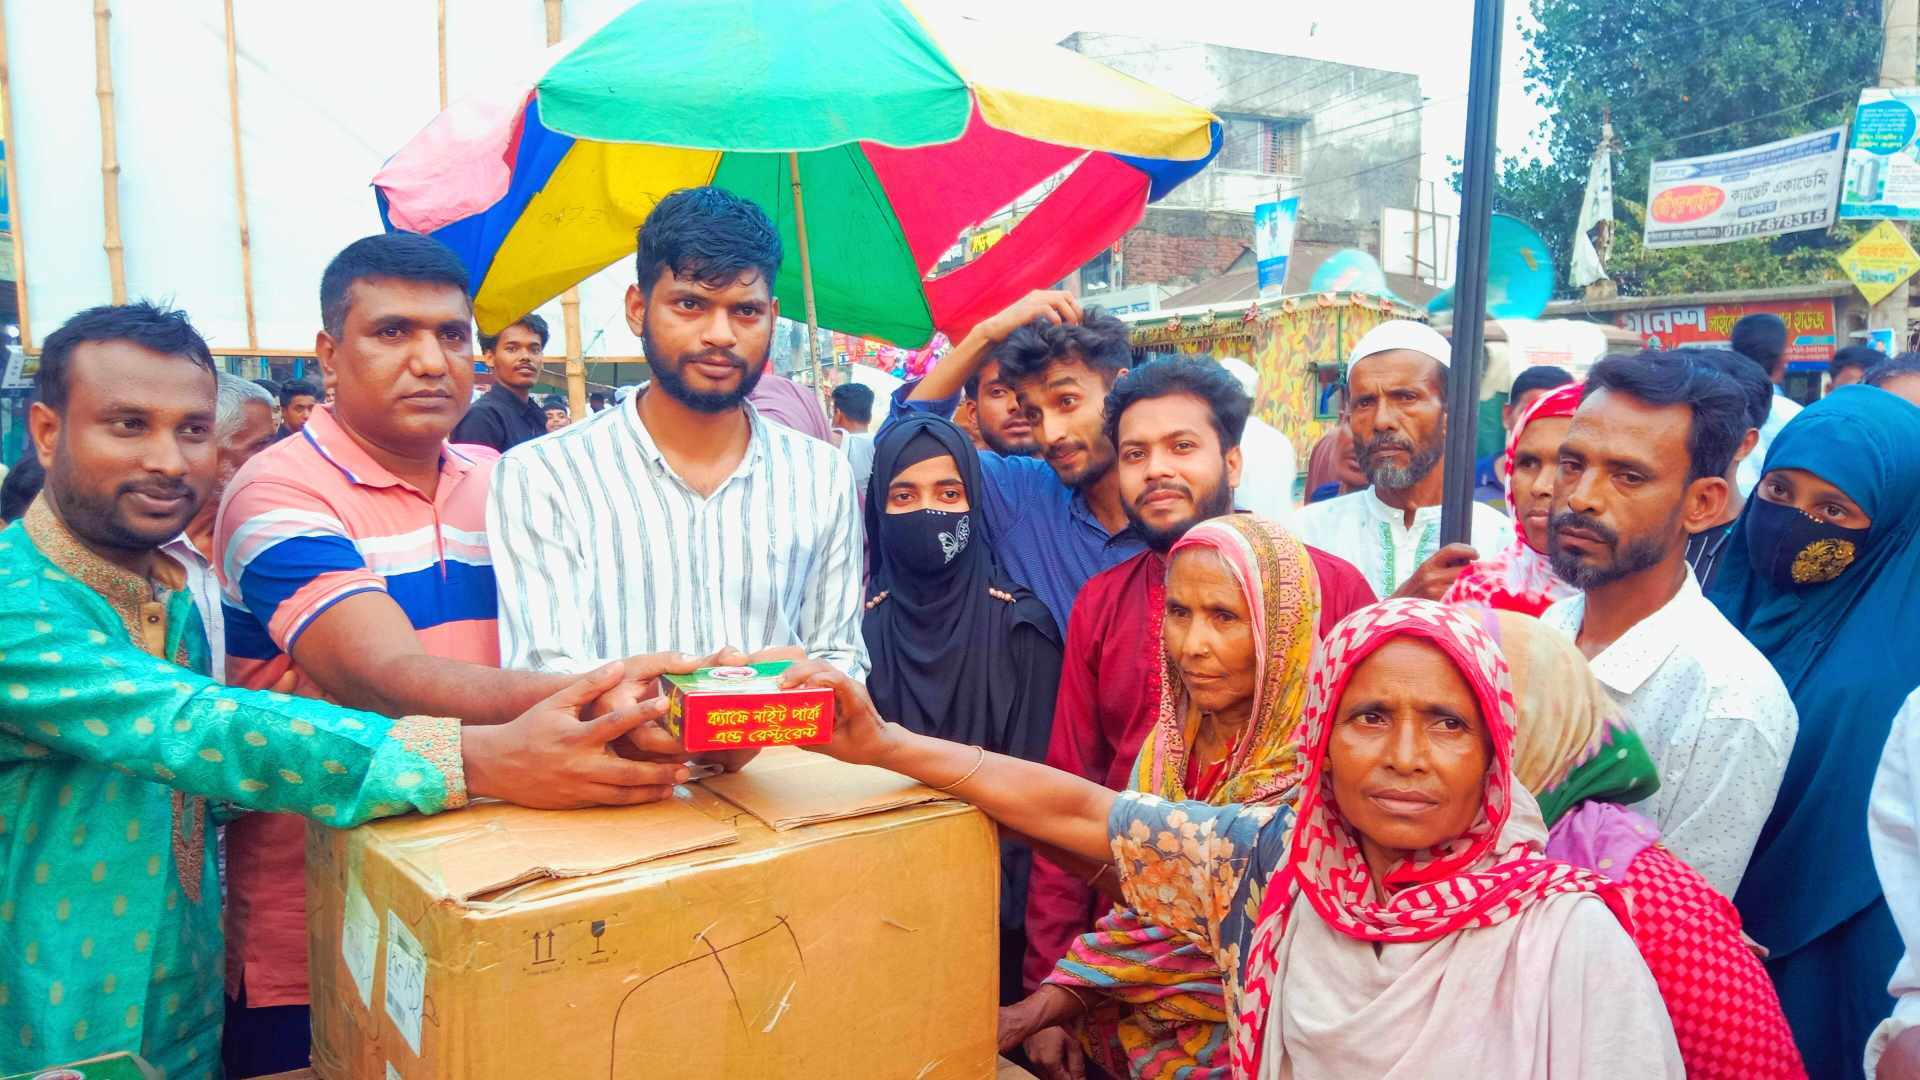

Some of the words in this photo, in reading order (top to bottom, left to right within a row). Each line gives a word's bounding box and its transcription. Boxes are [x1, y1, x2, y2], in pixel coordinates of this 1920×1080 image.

[707, 707, 750, 726] ক্যাফে
[752, 704, 788, 726] নাইট
[792, 702, 825, 723] পার্ক
